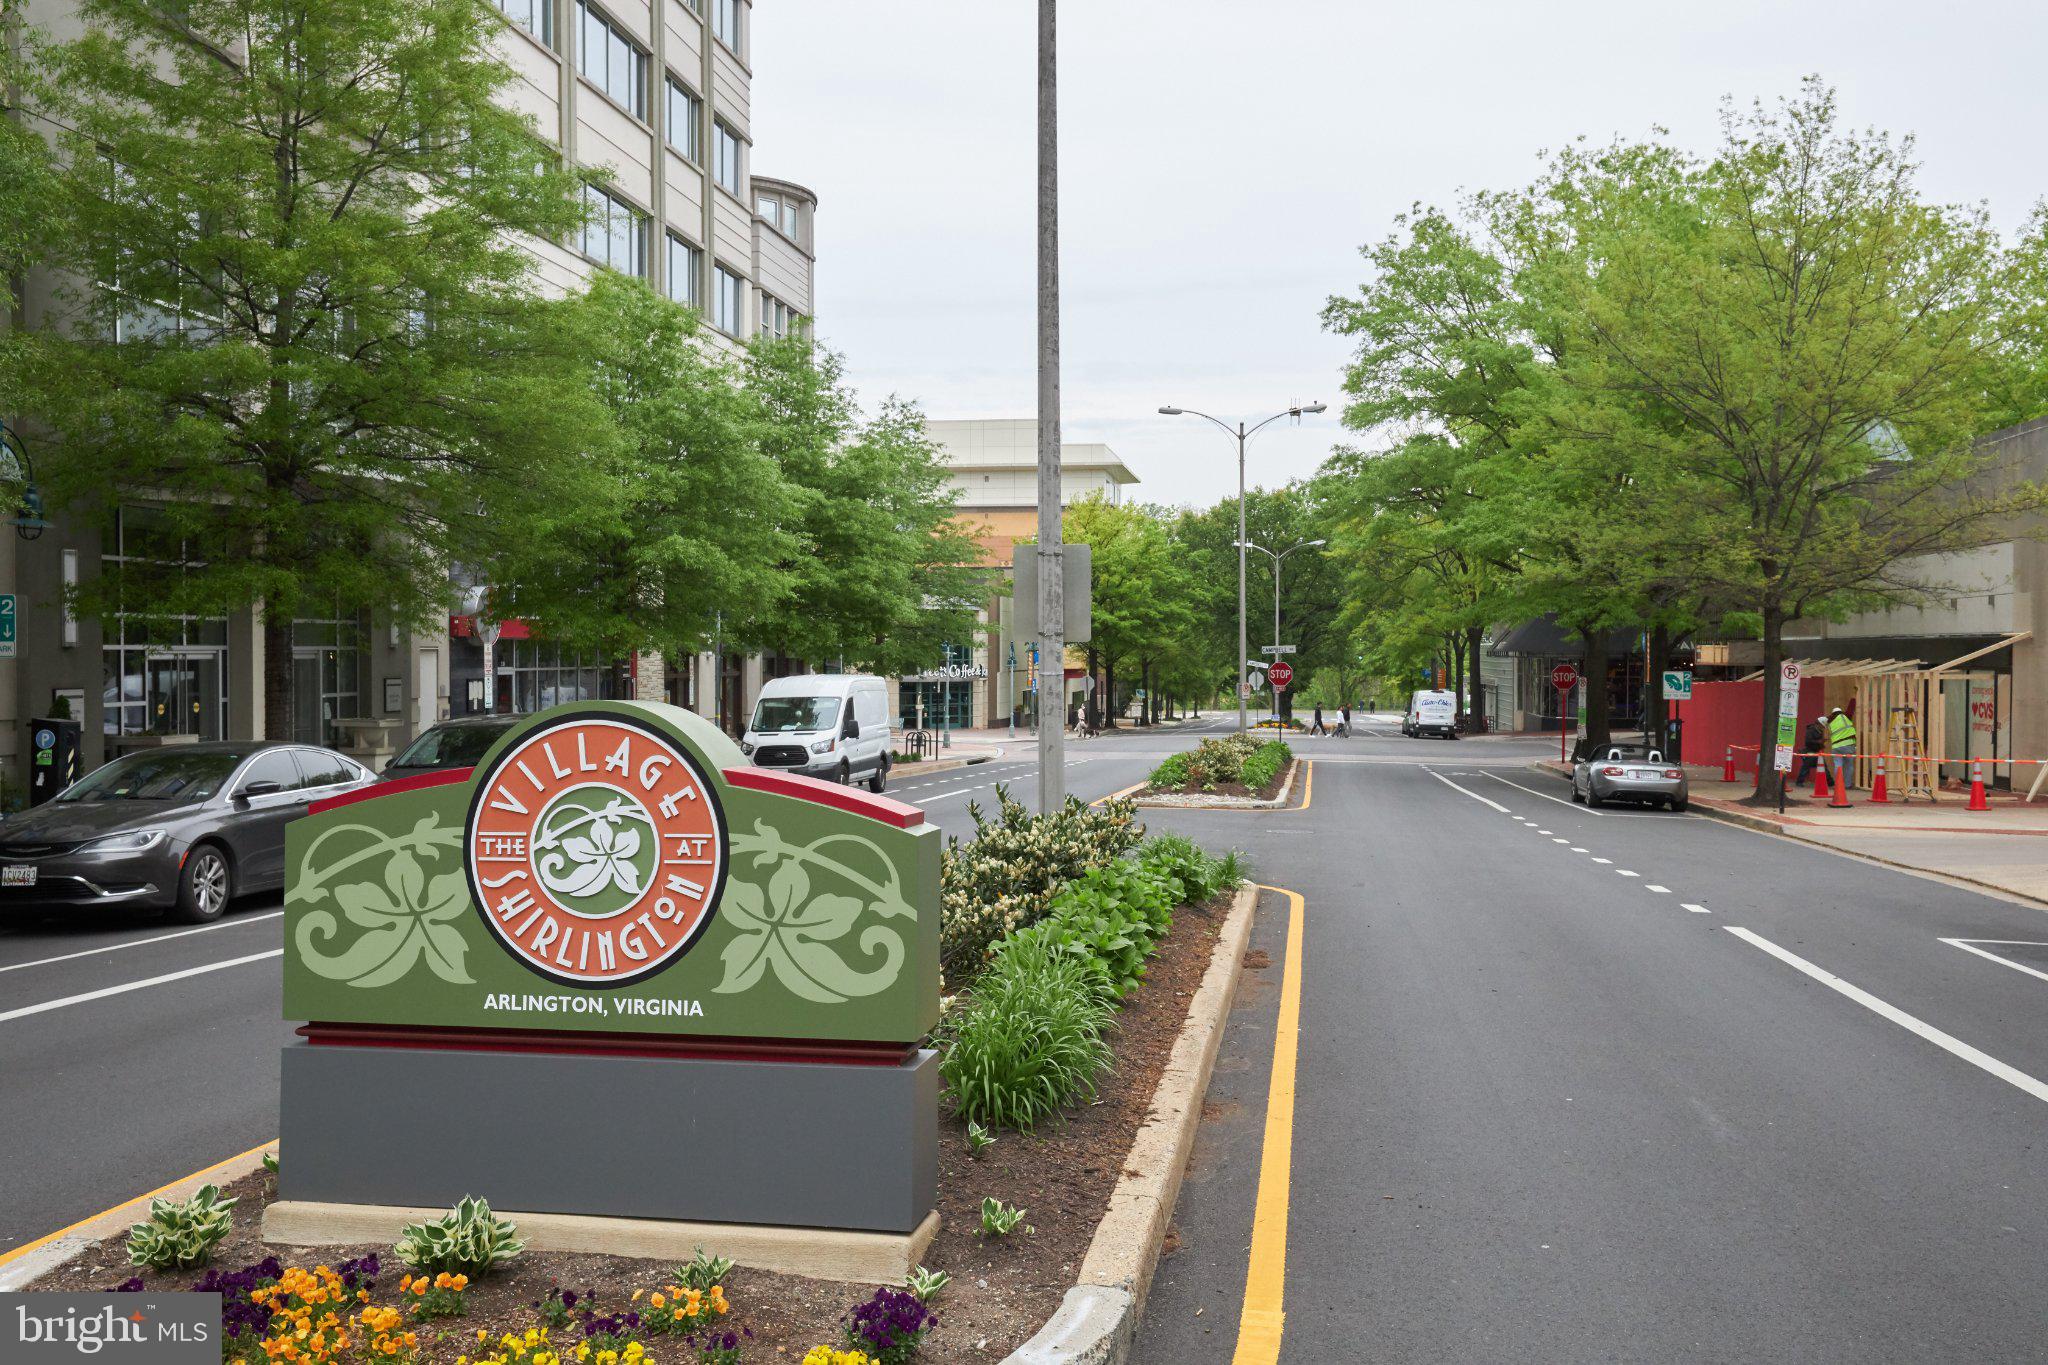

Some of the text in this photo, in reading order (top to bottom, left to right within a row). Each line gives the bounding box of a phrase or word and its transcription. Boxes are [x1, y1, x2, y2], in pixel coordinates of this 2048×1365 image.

[1, 599, 14, 615] 2
[949, 664, 975, 678] Coffee
[1270, 669, 1291, 679] STOP
[1553, 672, 1576, 682] STOP
[1979, 702, 1994, 719] CVS
[490, 732, 697, 820] VILLAGE
[480, 838, 526, 856] THE
[676, 839, 708, 857] AT
[481, 869, 705, 971] SHIRLINGTON
[483, 993, 705, 1017] ARLINGTON, VIRGINIA
